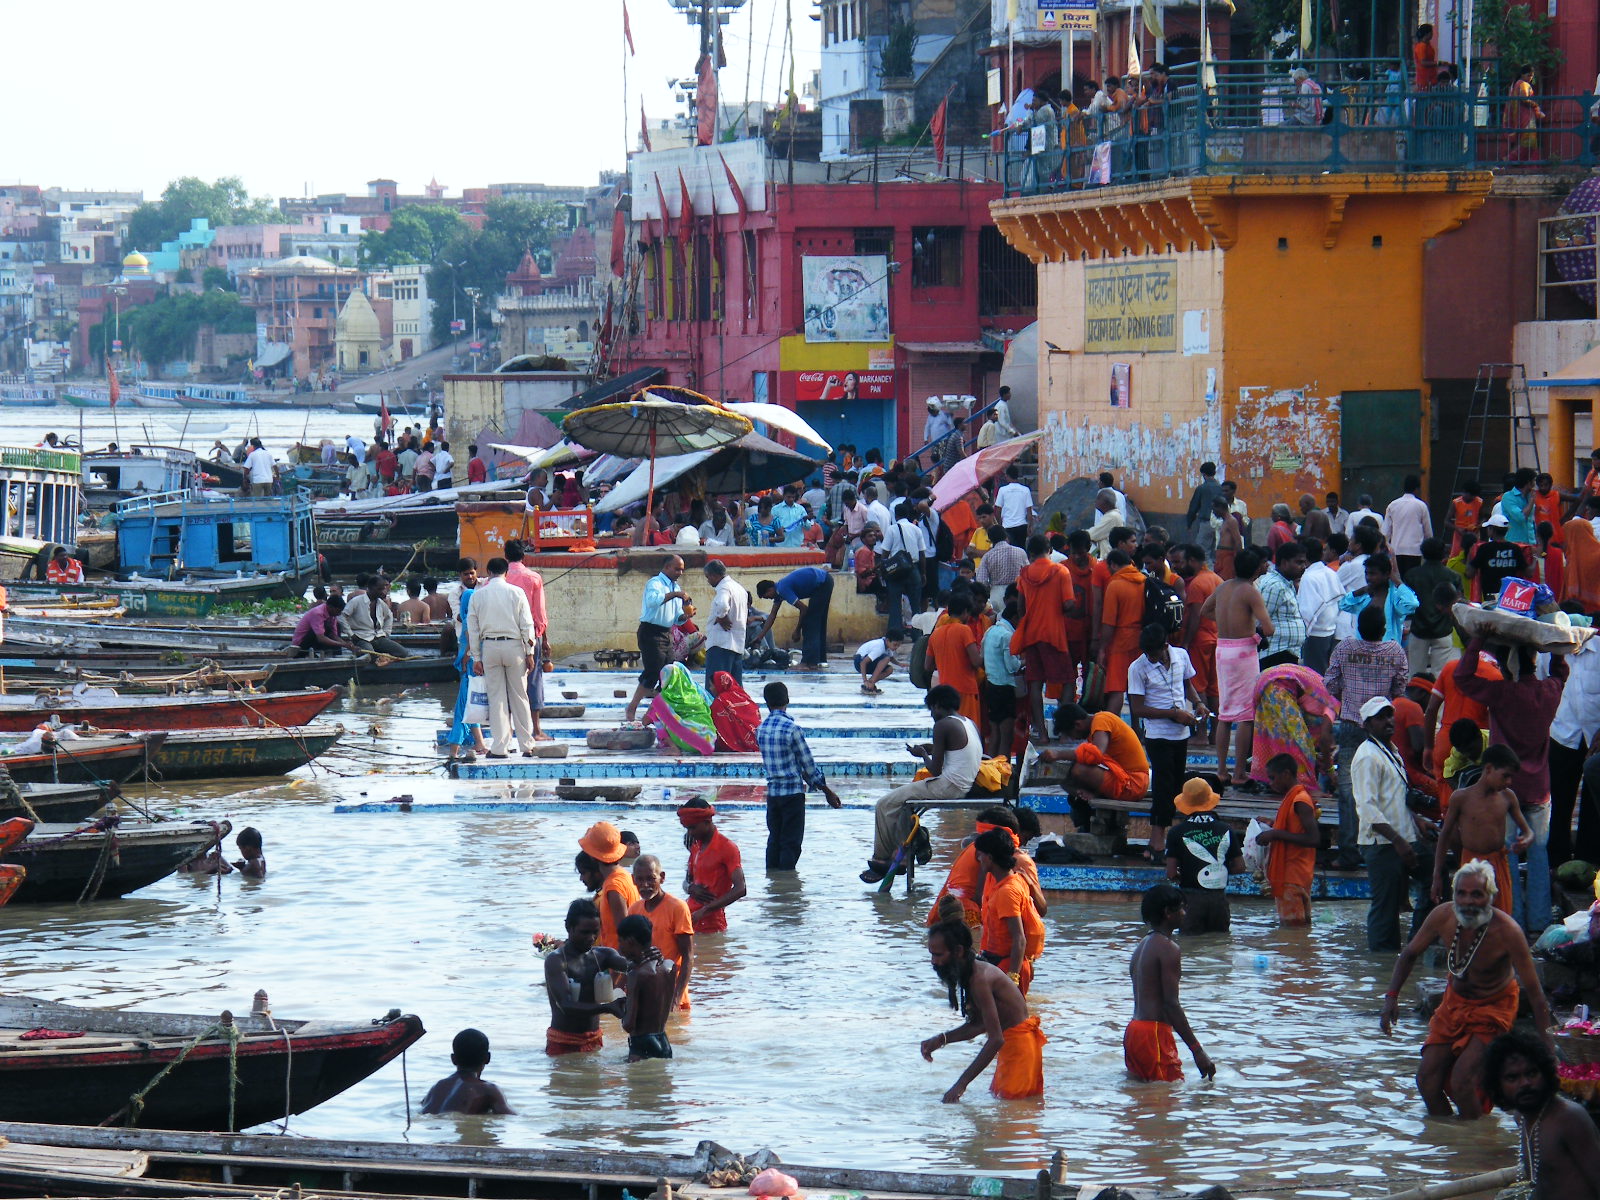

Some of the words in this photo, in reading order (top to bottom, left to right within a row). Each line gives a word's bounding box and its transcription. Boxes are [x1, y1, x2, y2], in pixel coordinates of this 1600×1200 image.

[1127, 315, 1156, 340] PRAYAG
[1157, 313, 1175, 338] GHAT
[859, 375, 893, 384] MARKANDEY
[870, 385, 882, 393] PAN
[1496, 549, 1513, 558] ICE
[1502, 597, 1529, 611] MART
